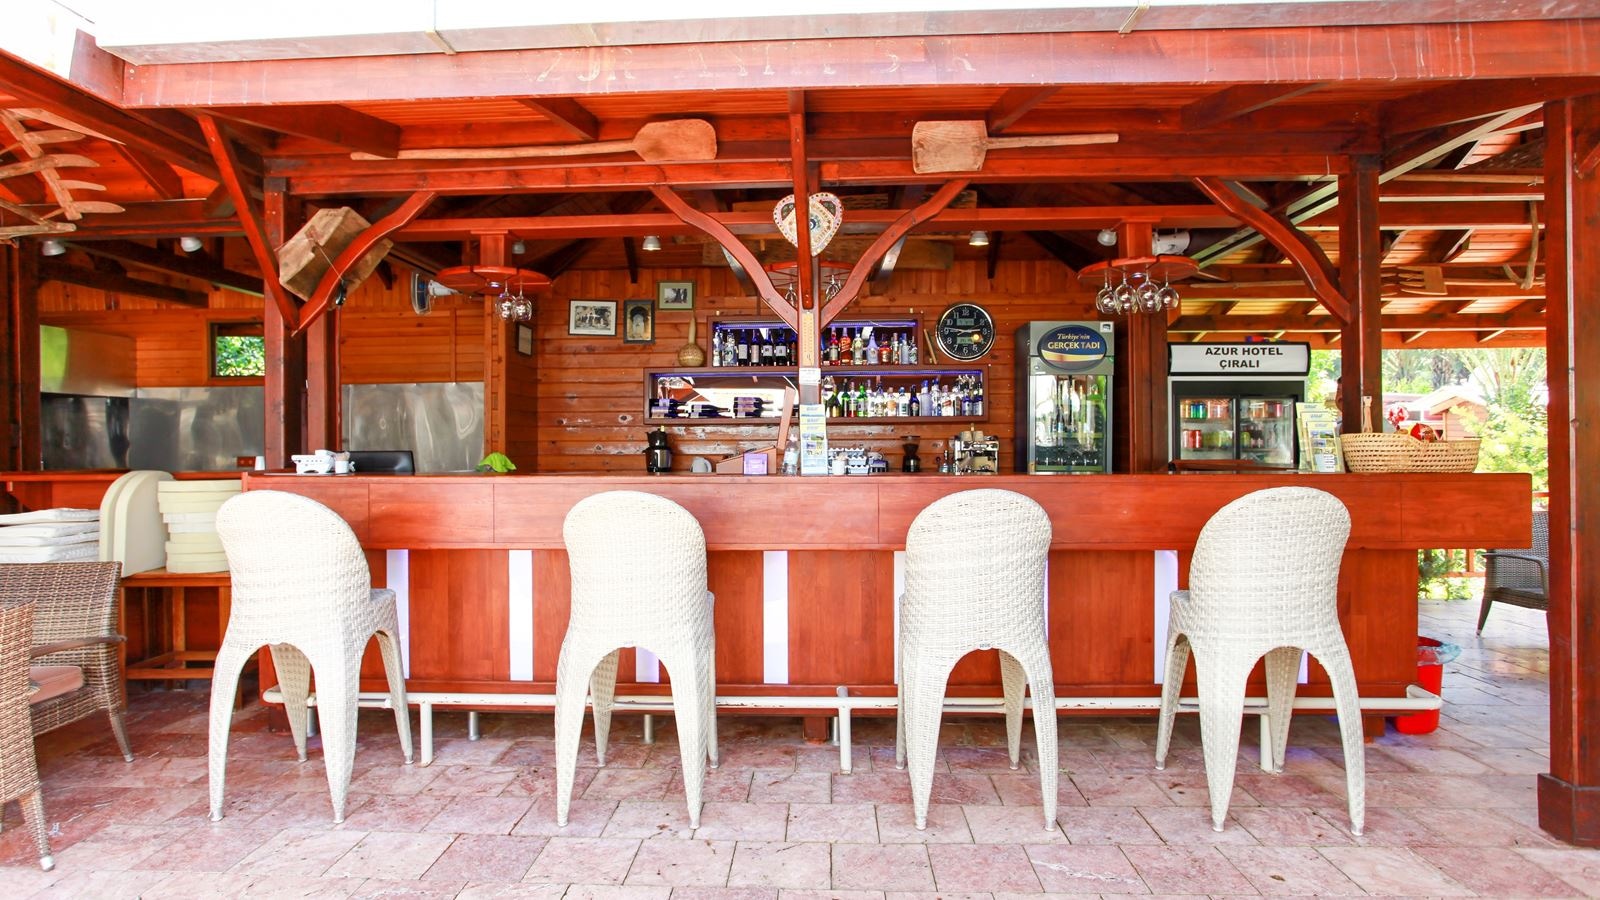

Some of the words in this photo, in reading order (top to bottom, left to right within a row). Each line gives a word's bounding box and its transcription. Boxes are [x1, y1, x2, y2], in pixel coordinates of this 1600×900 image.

[1047, 341, 1080, 351] GERÇEK
[1080, 341, 1100, 349] TADI
[1205, 347, 1238, 356] AZUR
[1242, 347, 1284, 356] HOTEL
[1219, 359, 1260, 370] ÇIRALI
